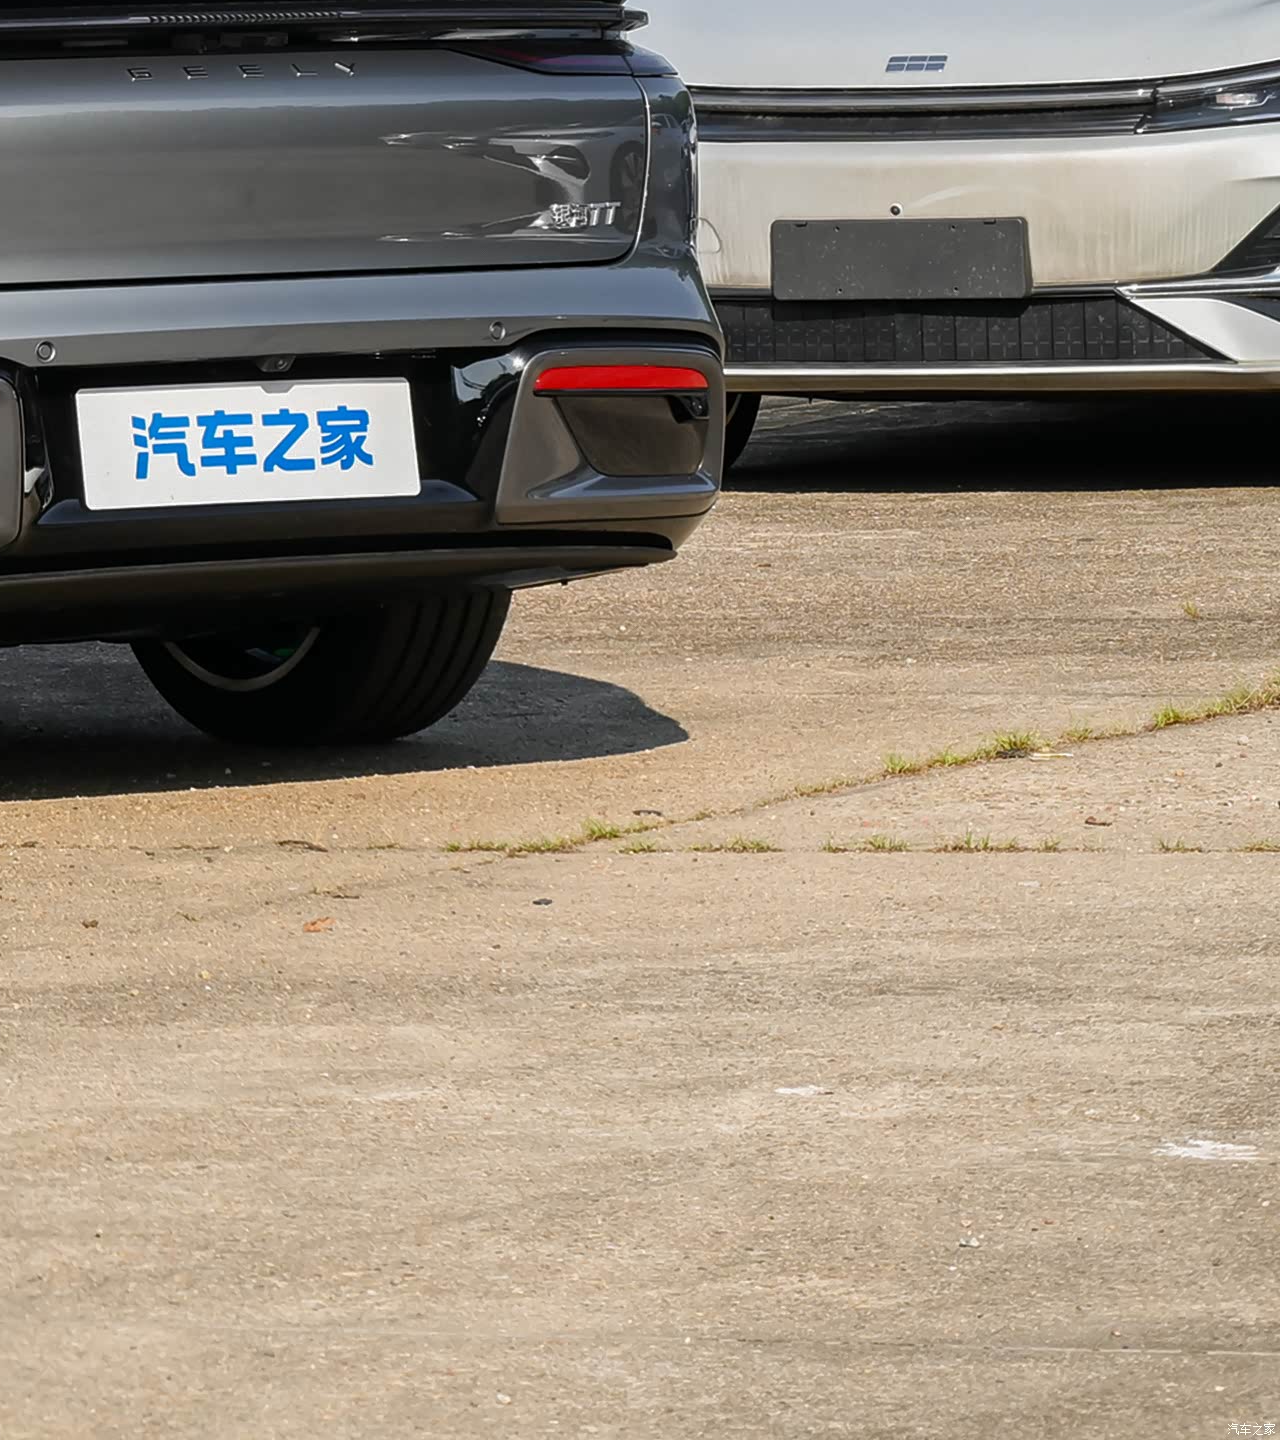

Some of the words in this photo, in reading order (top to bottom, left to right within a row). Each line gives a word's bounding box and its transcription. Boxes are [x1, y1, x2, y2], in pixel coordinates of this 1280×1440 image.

[127, 61, 356, 82] GEELY
[132, 406, 374, 480] 汽车之家
